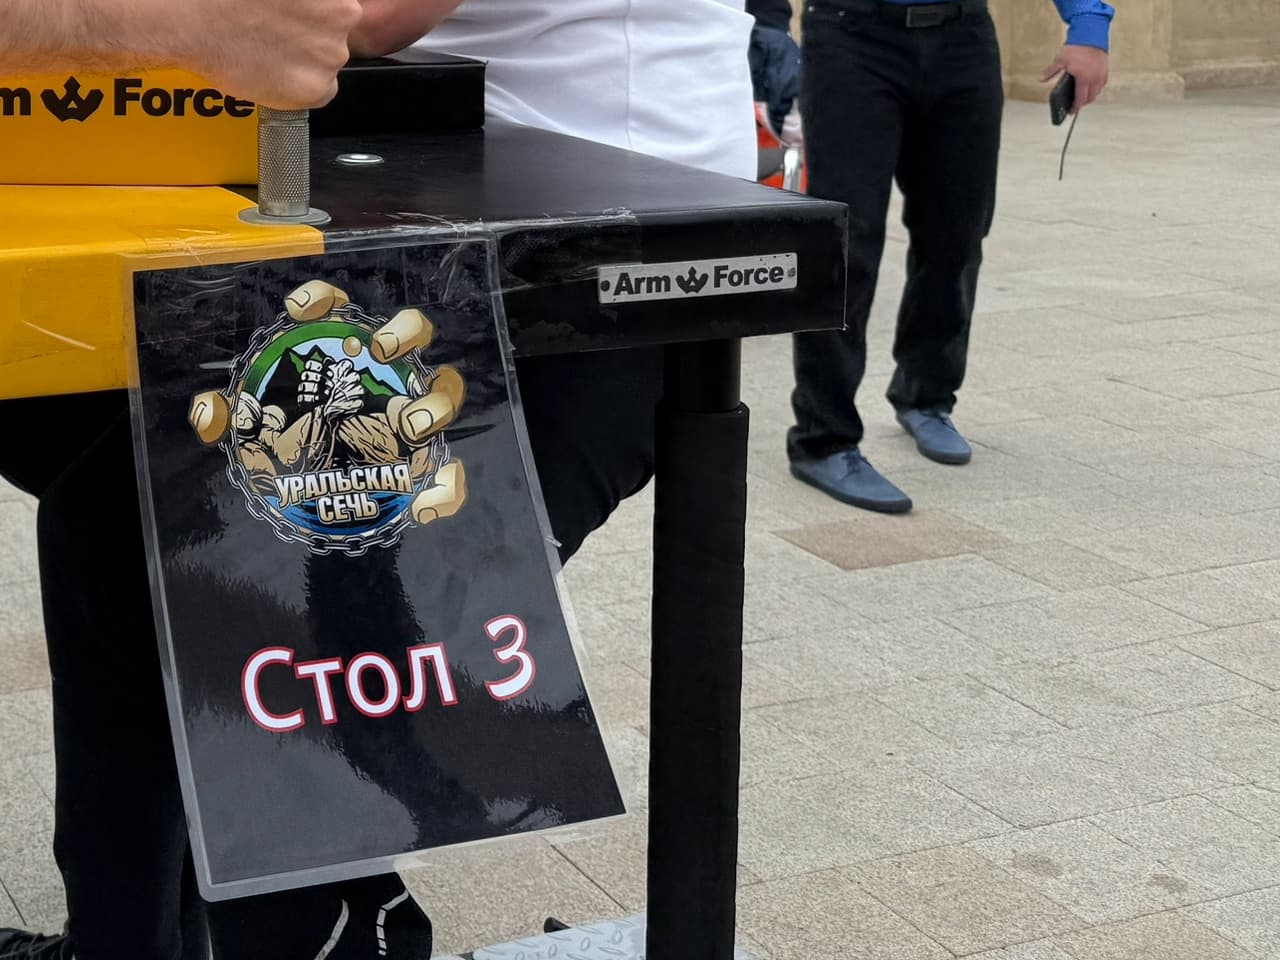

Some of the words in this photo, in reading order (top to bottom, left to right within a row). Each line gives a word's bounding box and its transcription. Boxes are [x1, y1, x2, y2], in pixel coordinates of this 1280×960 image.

[113, 78, 255, 118] Force
[613, 271, 671, 296] Arm
[713, 264, 785, 289] Force
[274, 464, 414, 510] УРАЛЬСКАЯ
[318, 492, 379, 525] СЕЧЬ
[241, 642, 458, 733] Стол
[484, 614, 536, 701] 3
